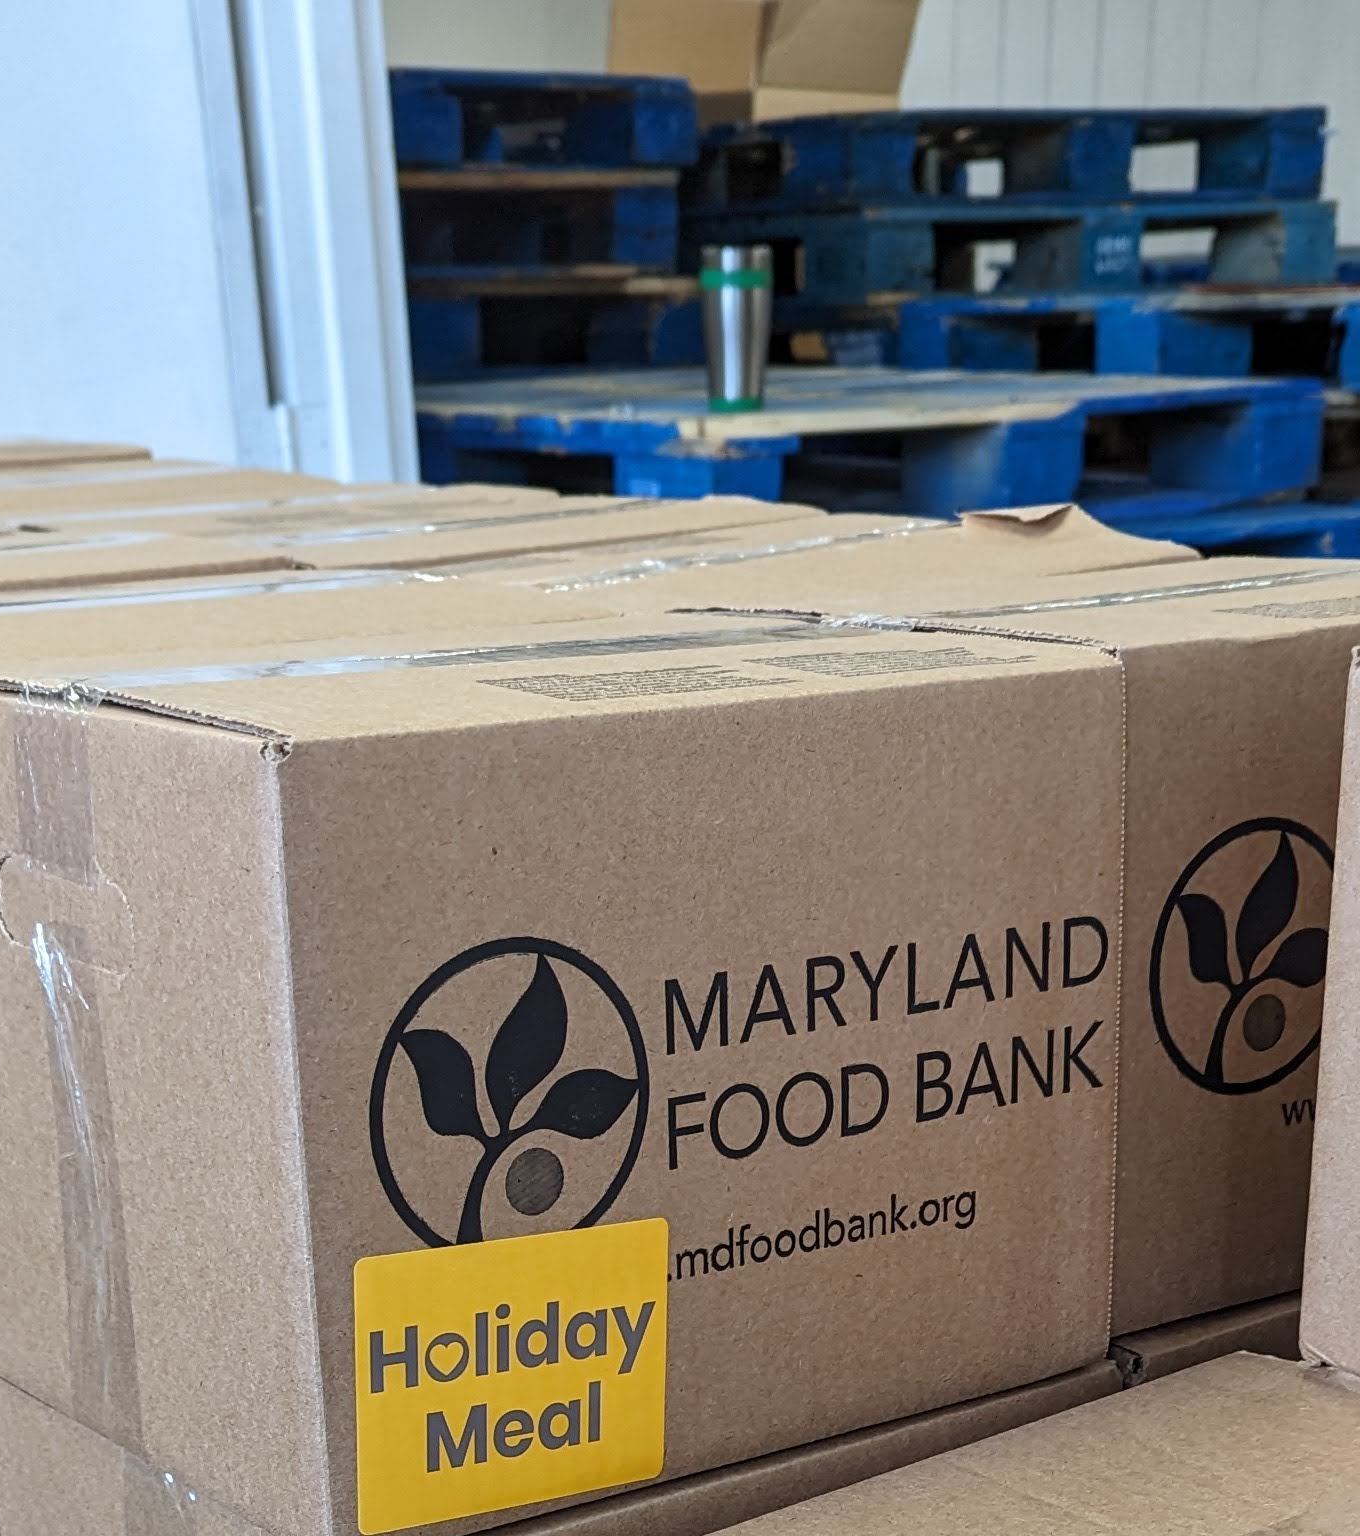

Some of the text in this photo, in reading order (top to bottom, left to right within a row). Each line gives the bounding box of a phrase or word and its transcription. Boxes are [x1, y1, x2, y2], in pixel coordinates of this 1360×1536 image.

[663, 914, 1110, 1056] MARYLAND
[667, 1019, 1105, 1171] FOOD BANK
[367, 1299, 657, 1395] Holiday
[424, 1386, 603, 1473] Meal
